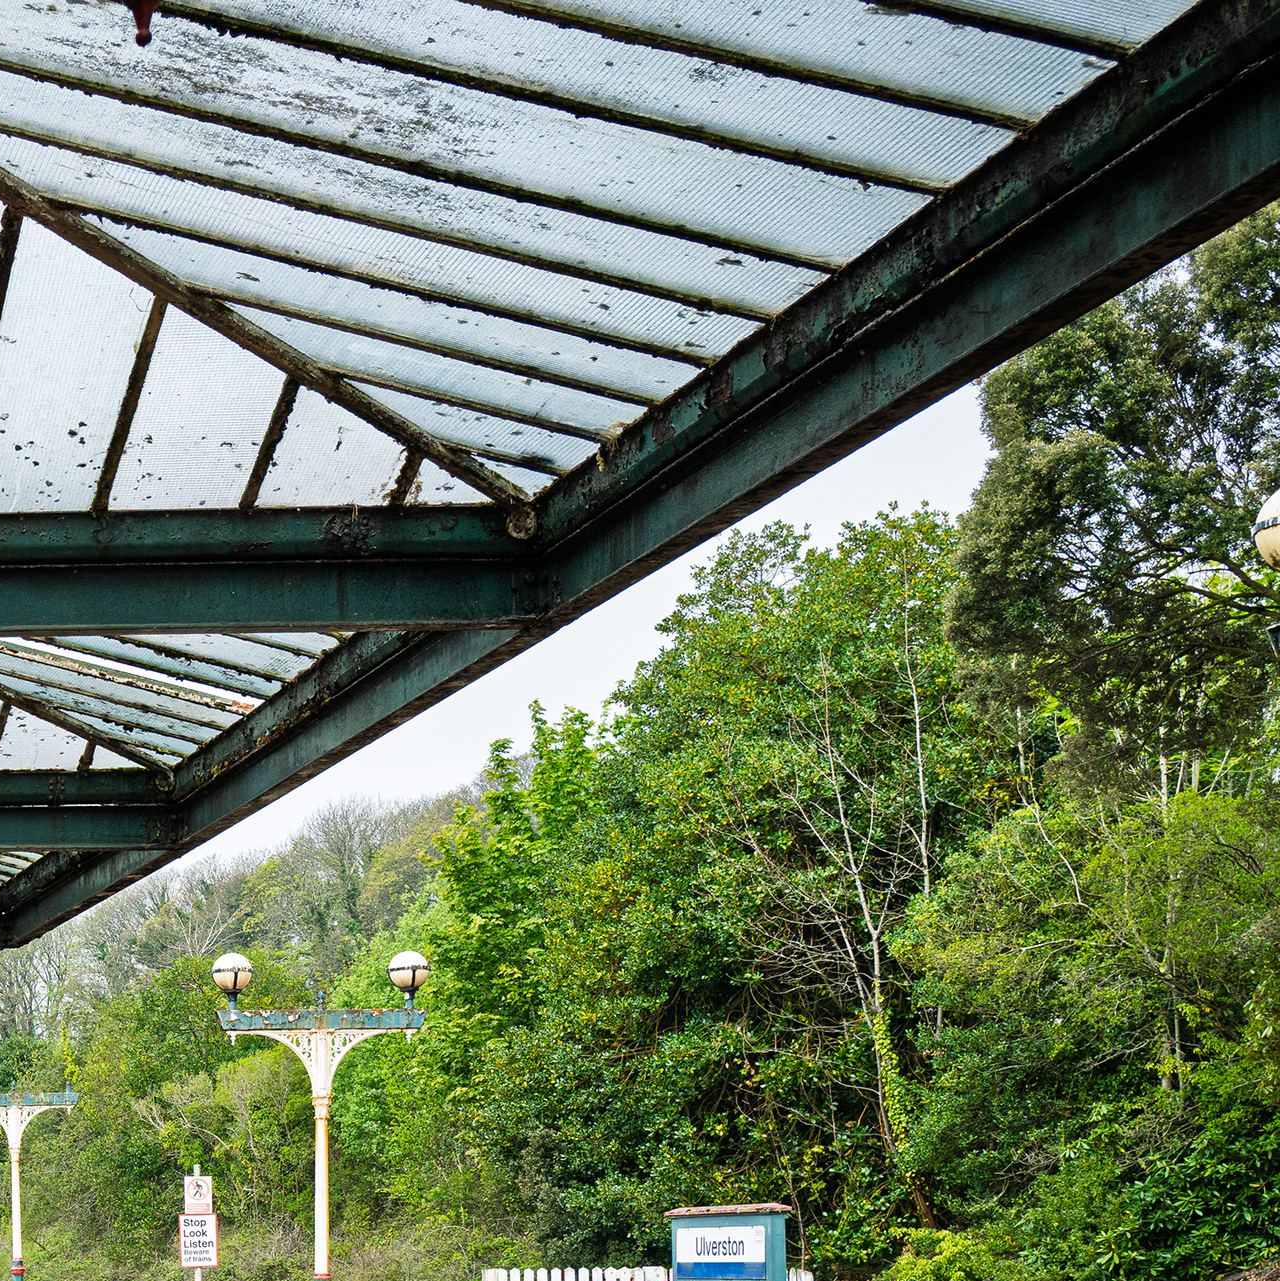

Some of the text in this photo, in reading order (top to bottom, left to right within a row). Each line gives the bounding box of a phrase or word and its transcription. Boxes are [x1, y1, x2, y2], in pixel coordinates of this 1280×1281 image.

[183, 1219, 206, 1227] Stop
[183, 1229, 207, 1237] Look
[184, 1240, 213, 1248] Listen
[696, 1236, 744, 1256] Ulverston
